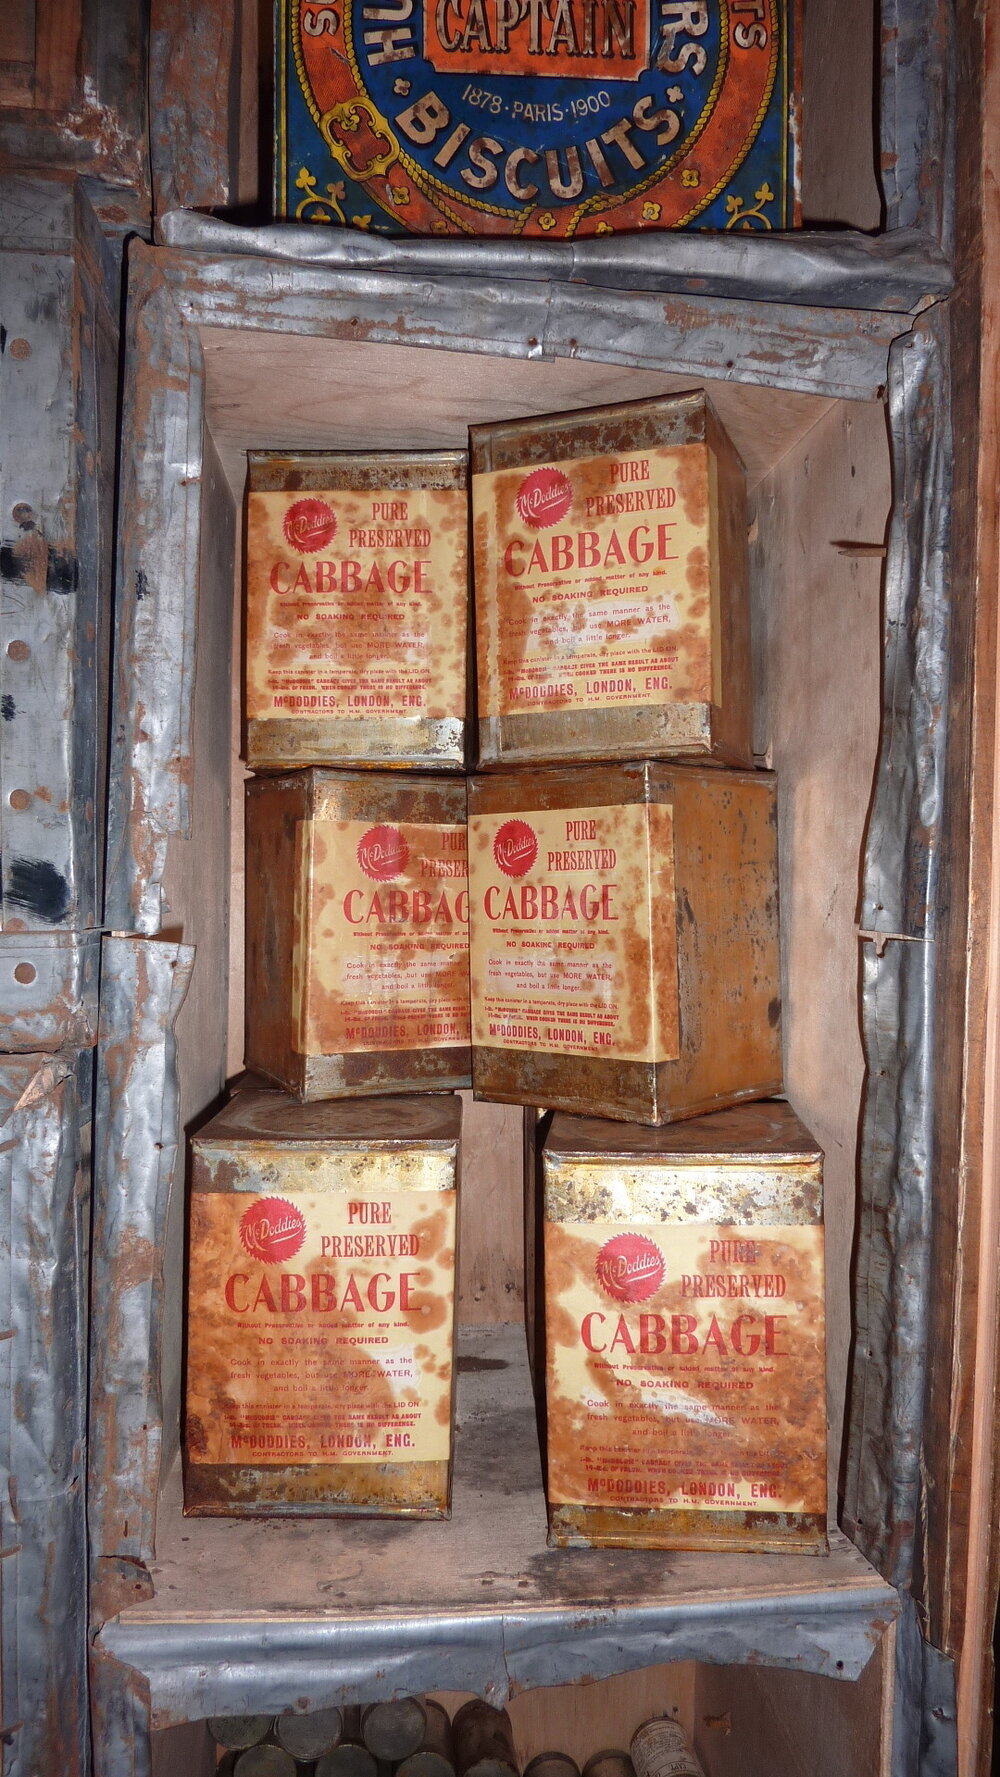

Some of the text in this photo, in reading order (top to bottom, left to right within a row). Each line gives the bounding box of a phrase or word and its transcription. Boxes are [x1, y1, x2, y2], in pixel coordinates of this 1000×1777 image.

[435, 0, 635, 57] CAPTAIN
[461, 84, 503, 114] 1878
[512, 101, 564, 122] PARIS
[395, 91, 681, 200] BISCUITS
[609, 459, 650, 484] PURE
[372, 502, 408, 521] PURE
[586, 487, 676, 517] PRESERVED
[348, 529, 432, 548] PRESERVED
[504, 522, 679, 578] CABBAGE
[269, 560, 433, 595] CABBAGE
[552, 592, 592, 601] SOAKING
[600, 586, 648, 596] REQUIRED
[607, 620, 632, 628] MORE
[638, 616, 671, 625] WATER,
[613, 607, 641, 616] manner
[606, 632, 631, 641] longer.
[586, 679, 637, 694] LONDON,
[645, 677, 673, 690] ENG.
[274, 696, 426, 708] McDODDIES, LONDON, ENG.
[441, 832, 467, 850] PUR
[565, 820, 597, 841] PURE
[420, 860, 468, 877] PRESER
[547, 849, 616, 871] PRESERVED
[343, 889, 470, 925] CABBAG
[484, 884, 619, 921] CABBAGE
[586, 973, 612, 981] WATER,
[417, 1023, 459, 1036] LONDON,
[490, 1023, 616, 1046] McDODDIES, LONDON, ENG.
[348, 1201, 392, 1224] PURE
[245, 1216, 303, 1251] McDoddies
[320, 1234, 420, 1258] PRESERVED
[709, 1239, 757, 1264] PURE
[600, 1253, 661, 1289] McDoddies
[224, 1272, 422, 1314] CABBAGE
[681, 1274, 787, 1298] PRESERVED
[259, 1337, 389, 1345] NO SOAKING REQUIRED
[581, 1311, 789, 1357] CABBAGE
[377, 1369, 413, 1378] WATER,
[616, 1379, 631, 1387] NO
[698, 1381, 753, 1390] REQUIRED
[587, 1400, 609, 1408] Cook
[587, 1413, 779, 1426] fresh WATER,
[320, 1434, 376, 1449] LONDON,
[386, 1433, 416, 1447] ENG.
[681, 1481, 741, 1499] LONDON,
[751, 1483, 782, 1499] ENG.
